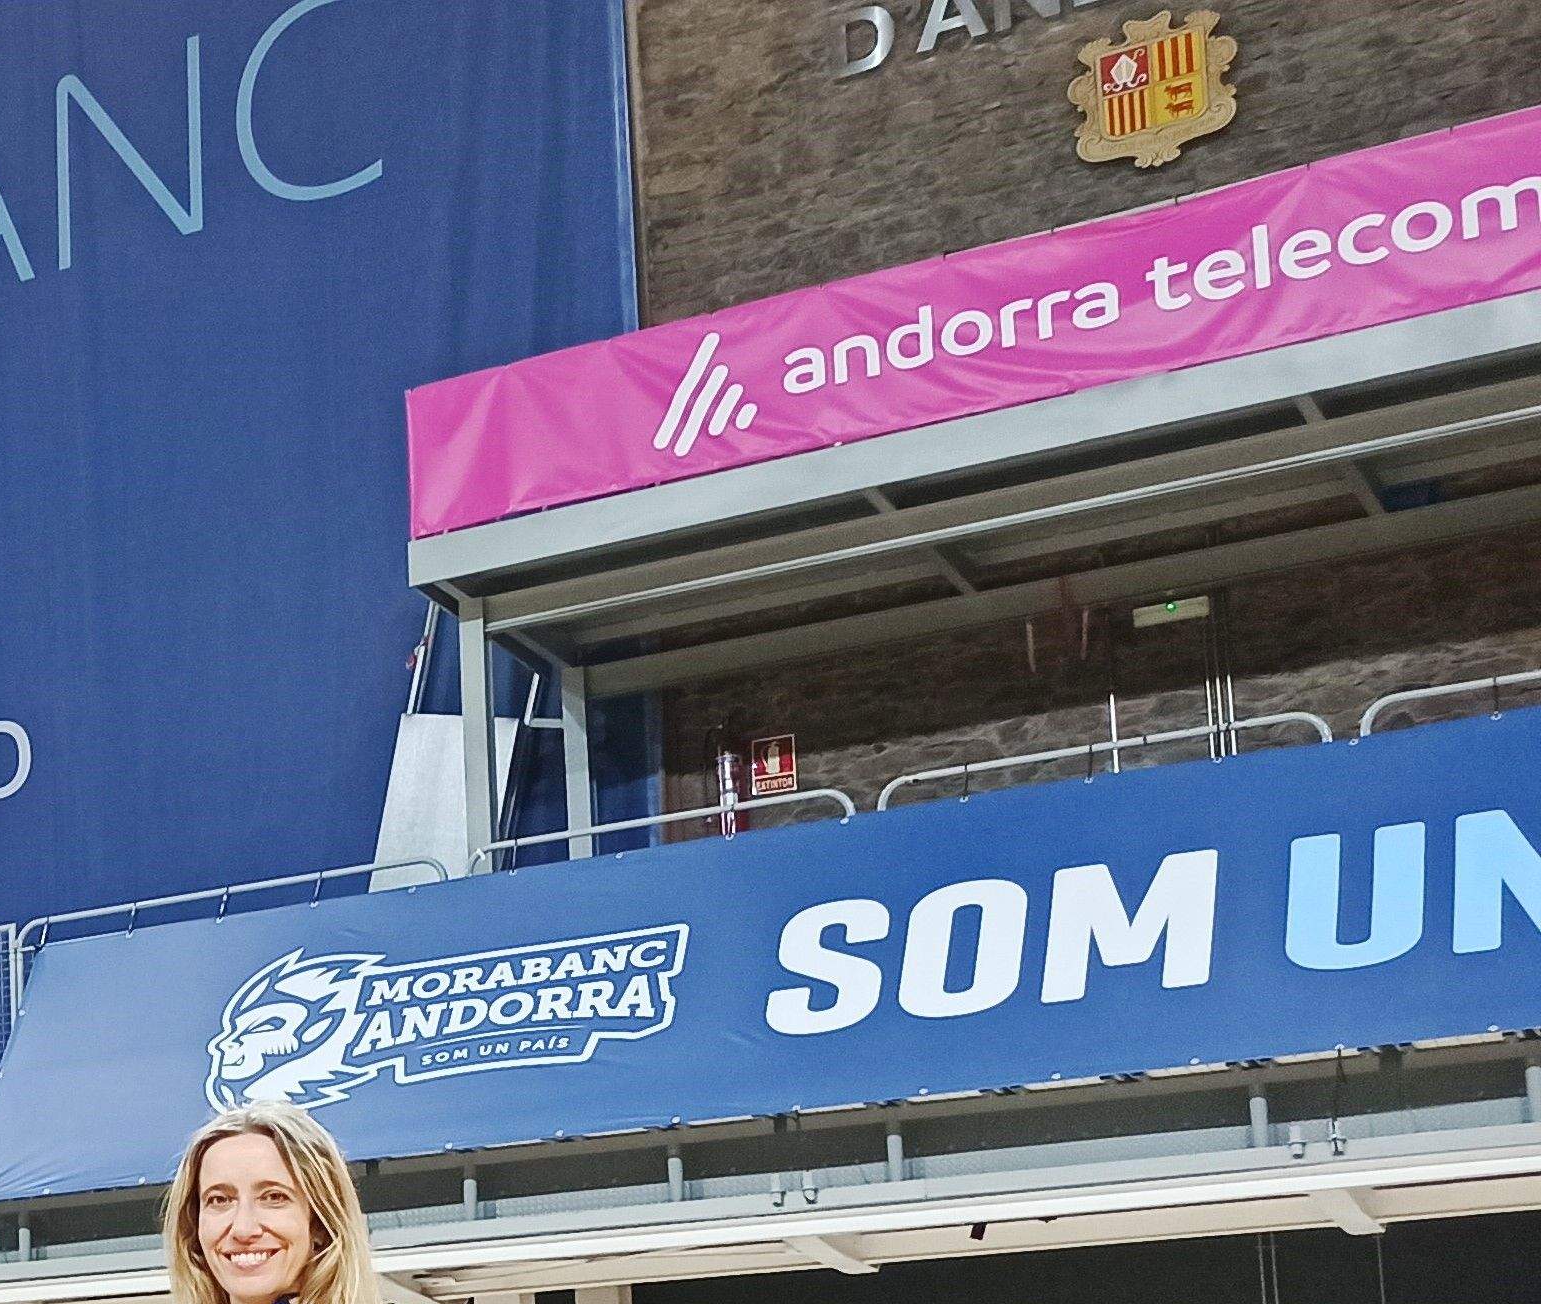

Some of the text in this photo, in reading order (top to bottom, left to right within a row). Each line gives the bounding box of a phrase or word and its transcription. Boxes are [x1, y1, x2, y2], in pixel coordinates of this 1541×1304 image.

[783, 176, 1541, 394] andorra telecom
[369, 939, 670, 1006] MORABANC
[765, 848, 1219, 1034] SOM
[352, 973, 656, 1057] ANDORRA
[421, 1048, 468, 1066] SOM
[478, 1042, 510, 1056] UN
